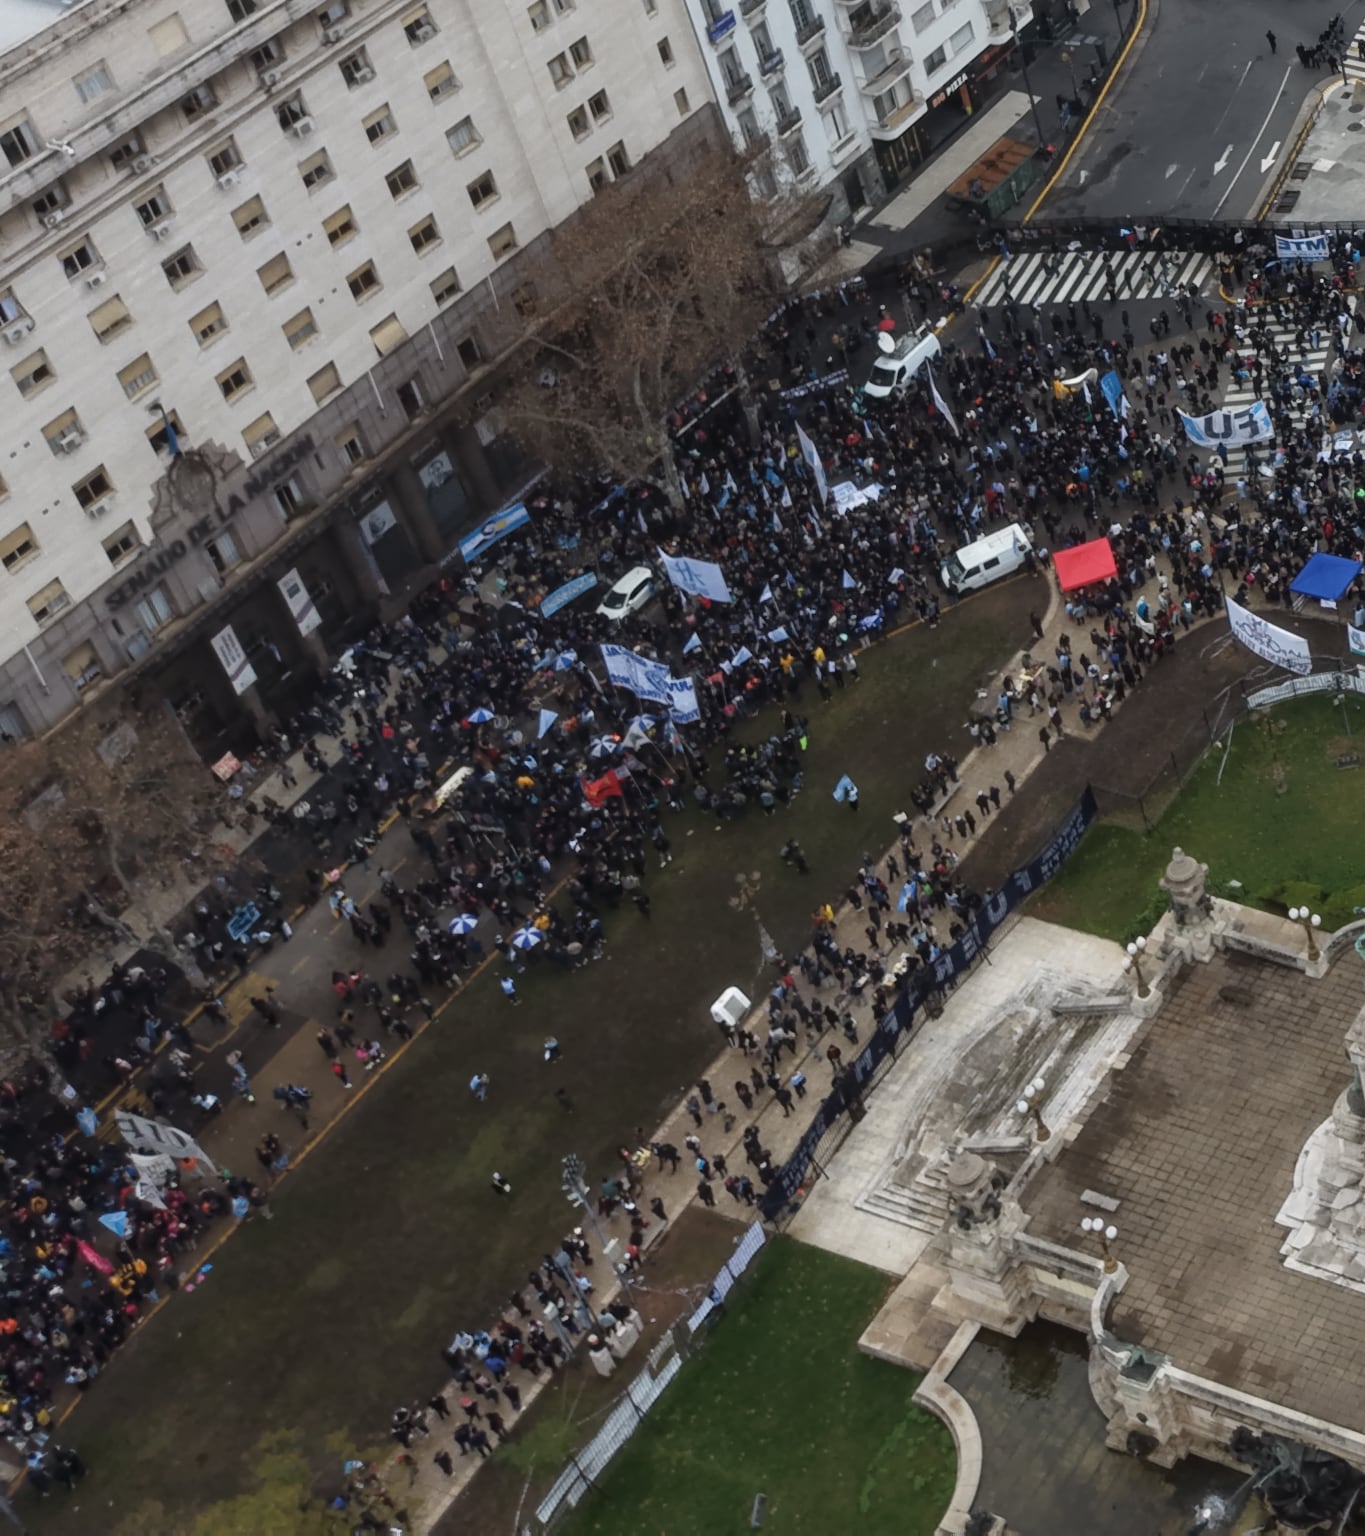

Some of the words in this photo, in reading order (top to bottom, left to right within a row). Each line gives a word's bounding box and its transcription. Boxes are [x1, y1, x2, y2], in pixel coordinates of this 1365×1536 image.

[105, 540, 188, 611] SENADO
[187, 514, 217, 550] DE
[215, 494, 246, 524] LA
